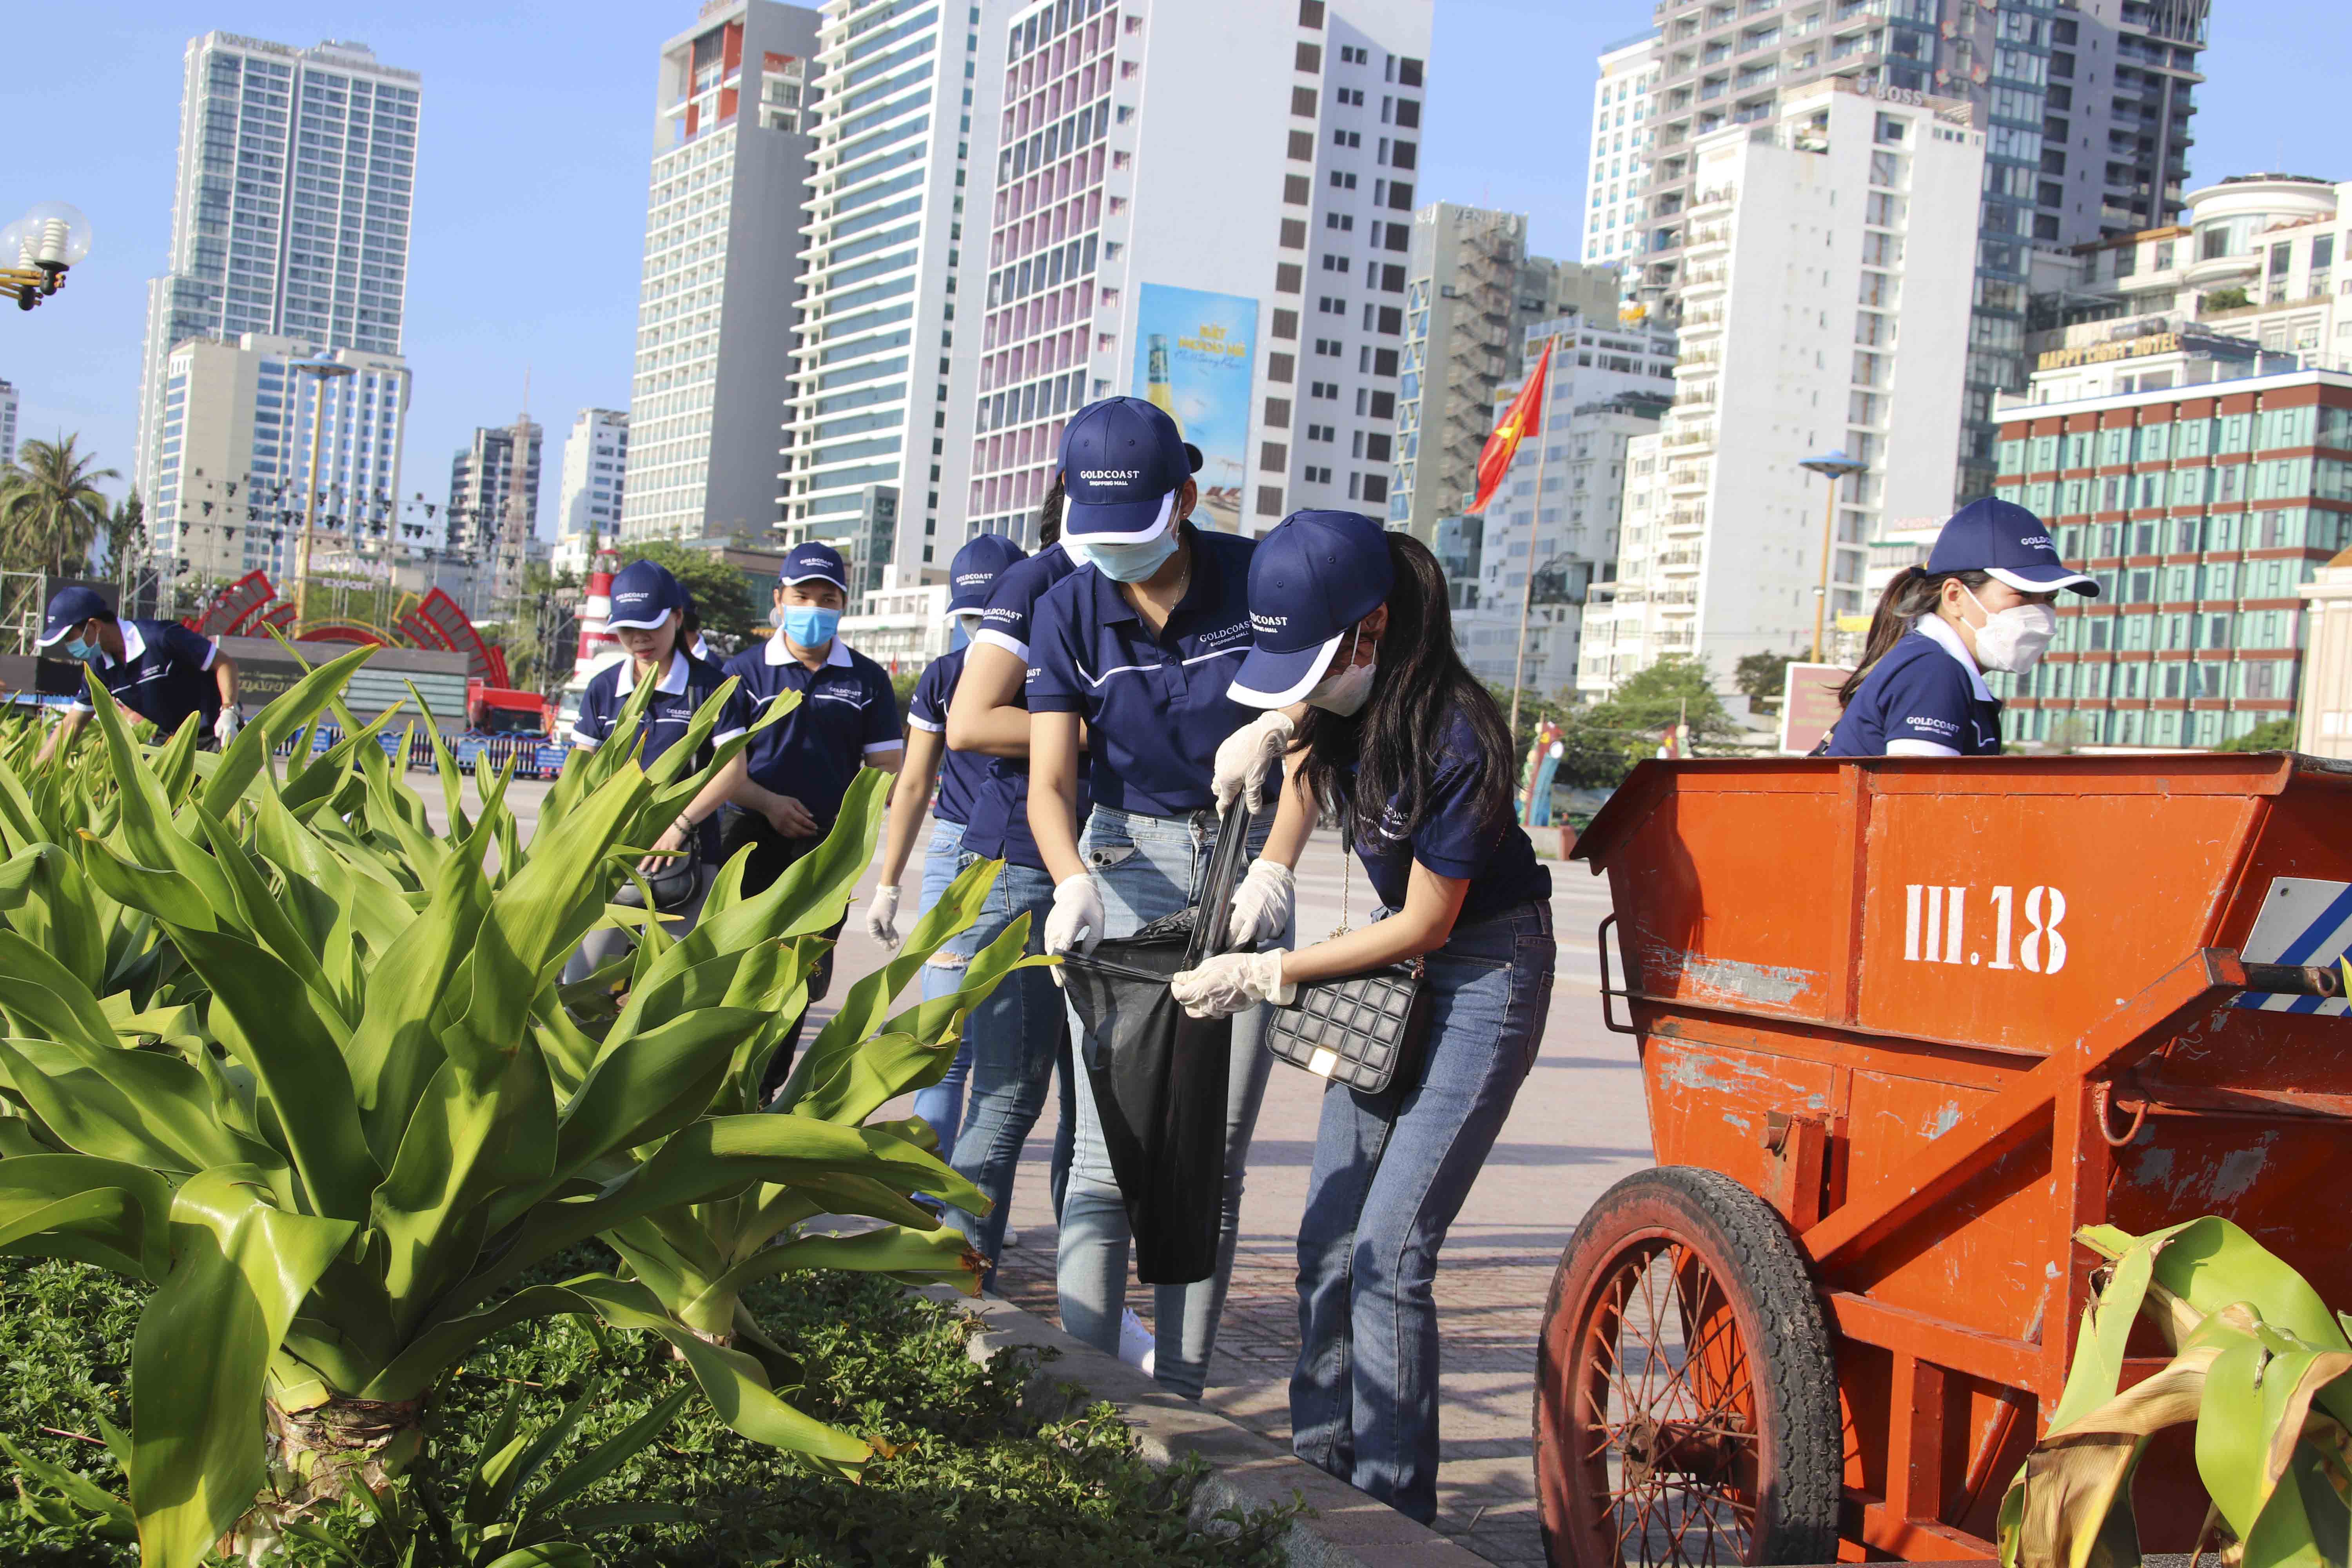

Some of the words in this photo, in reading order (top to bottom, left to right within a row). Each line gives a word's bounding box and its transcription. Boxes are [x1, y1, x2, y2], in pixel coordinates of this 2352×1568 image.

[2038, 347, 2083, 370] HAPPY
[2132, 332, 2180, 356] HOTEL
[1080, 470, 1140, 479] GOLDCOAST
[323, 578, 374, 591] EXPORT
[956, 573, 993, 583] GOLDCOAST
[1210, 635, 1235, 647] SHOPPING
[1906, 716, 1960, 733] GOLDCOAST
[1904, 884, 2067, 975] III.18
